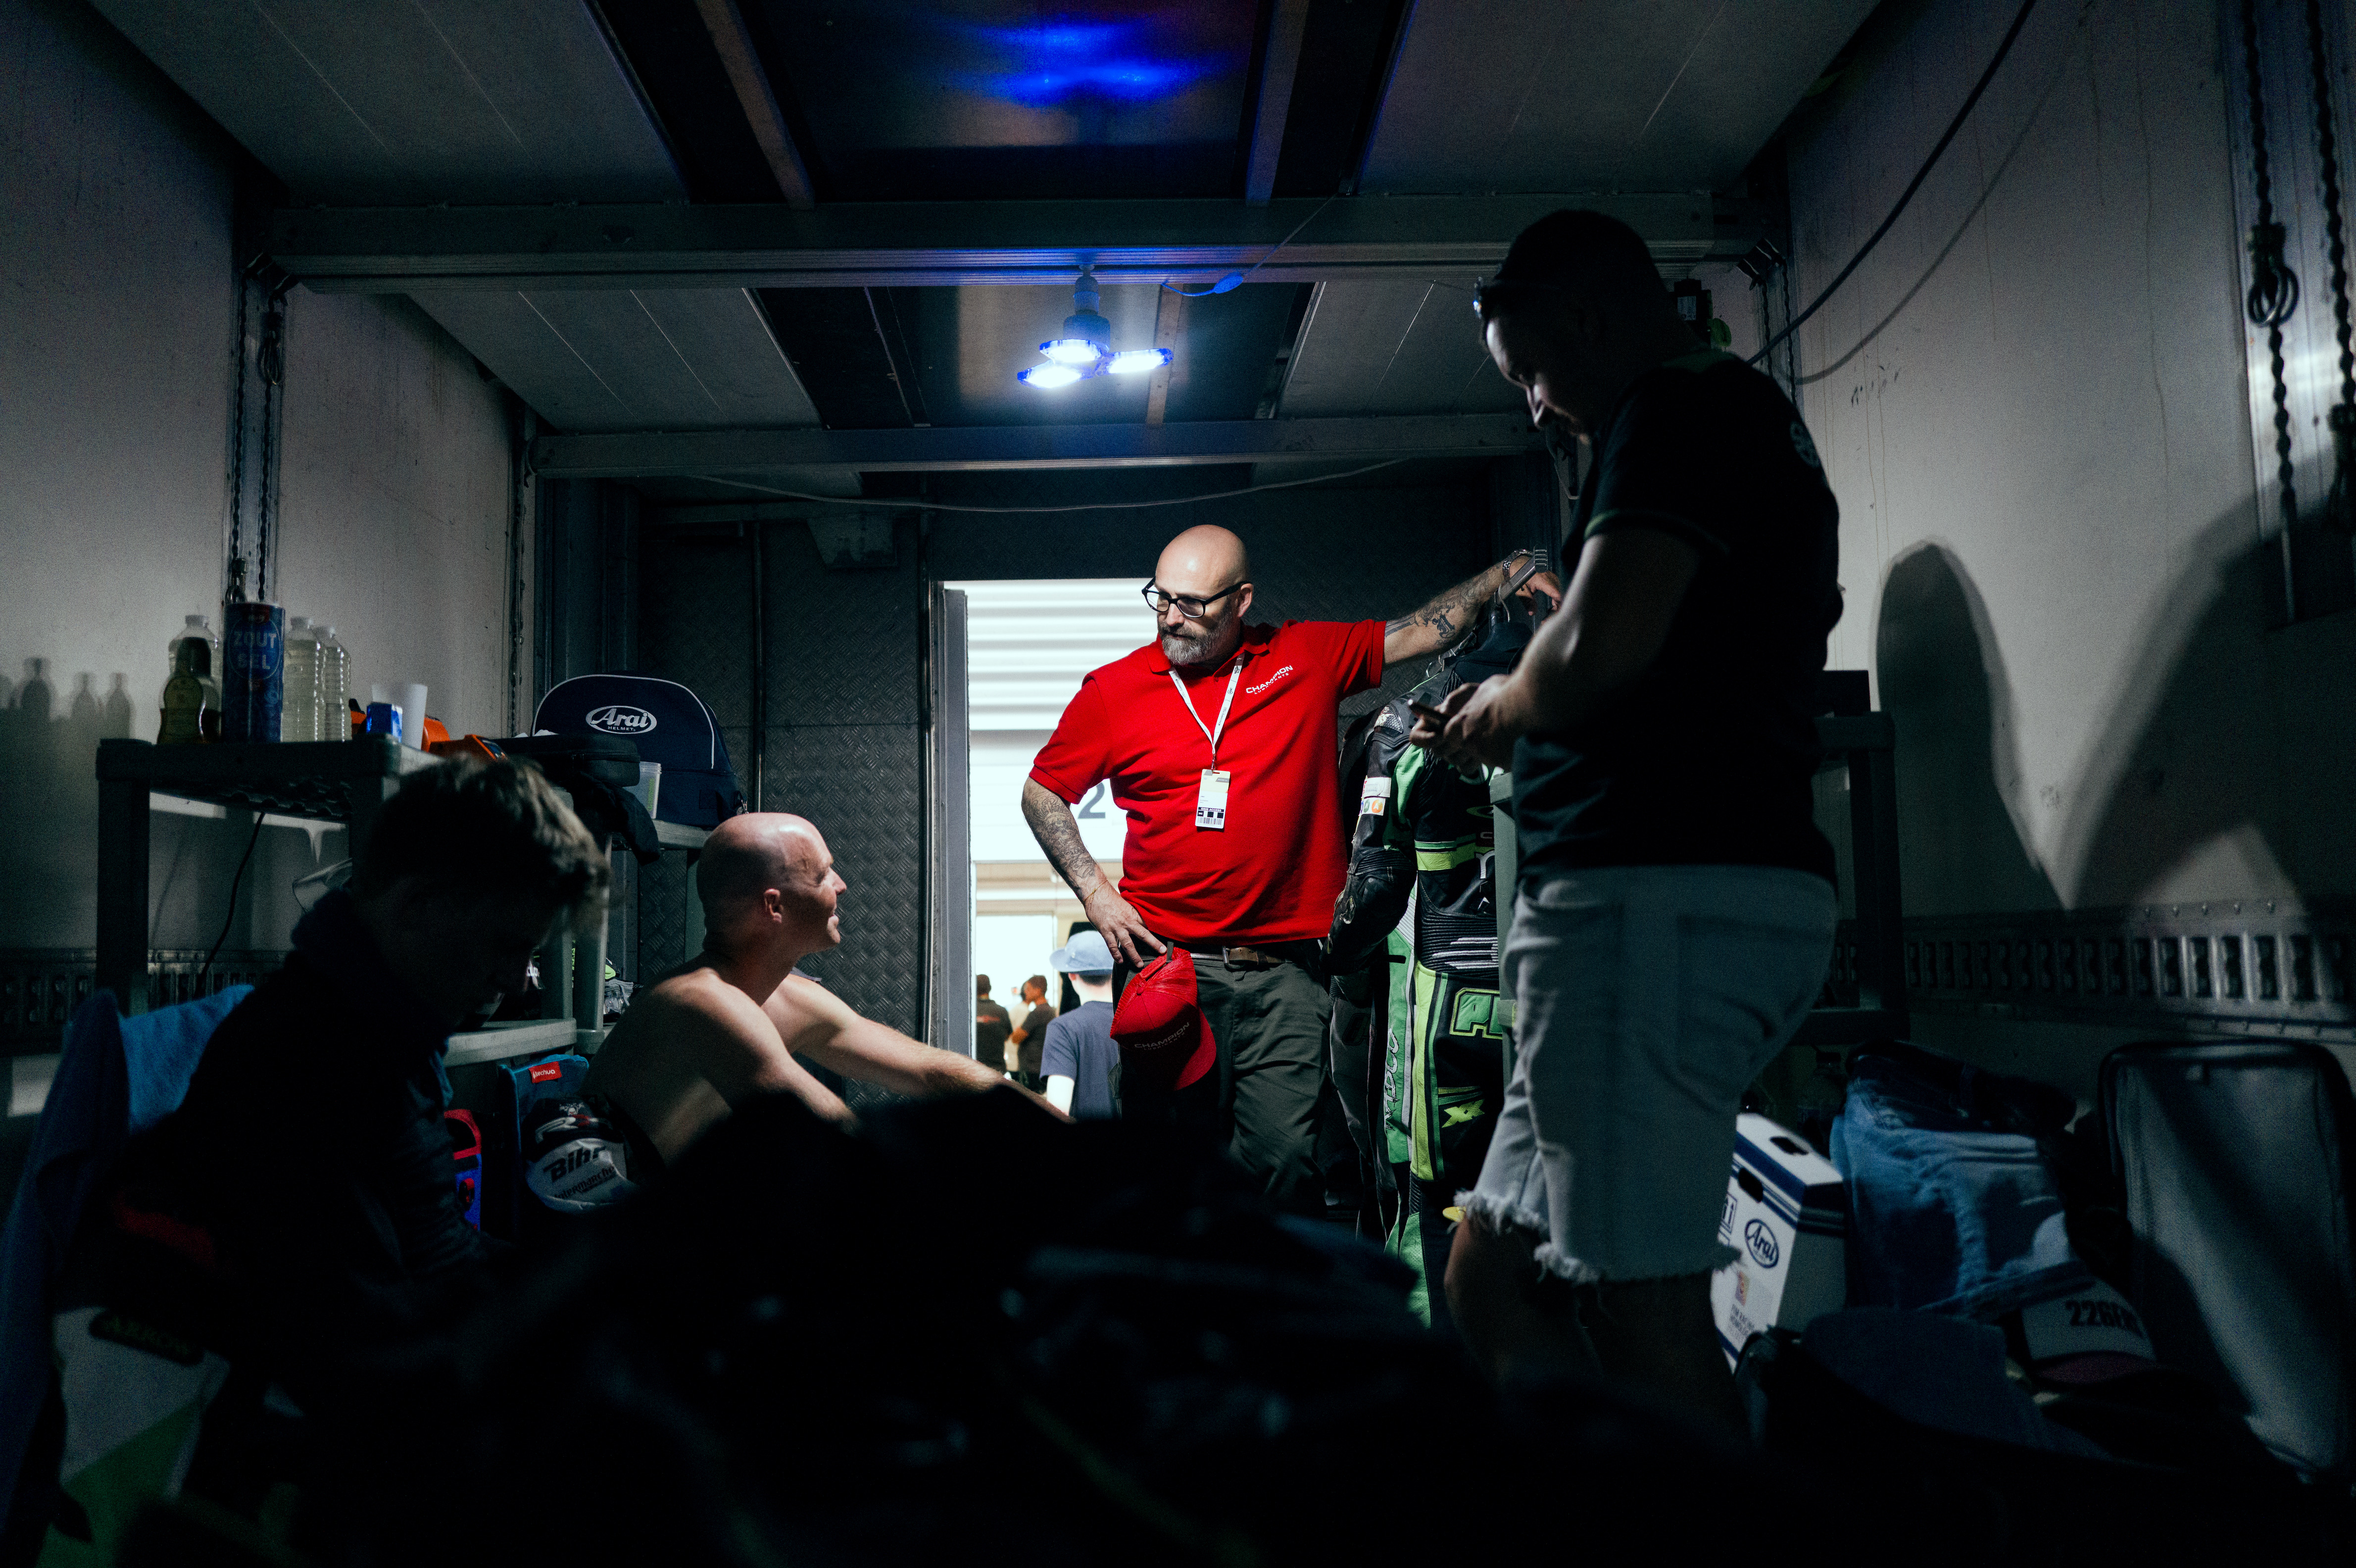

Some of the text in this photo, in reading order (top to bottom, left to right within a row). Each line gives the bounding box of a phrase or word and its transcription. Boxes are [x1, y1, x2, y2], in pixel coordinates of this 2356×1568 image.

[233, 631, 277, 649] ZOUT
[237, 652, 271, 670] SEL
[1246, 665, 1293, 693] CHAMPION
[590, 708, 649, 728] Arai
[1134, 1022, 1190, 1048] CHAMPION
[1144, 1032, 1185, 1050] LUBRICANTS
[543, 1145, 606, 1183] Bihr
[1747, 1225, 1775, 1261] Arai
